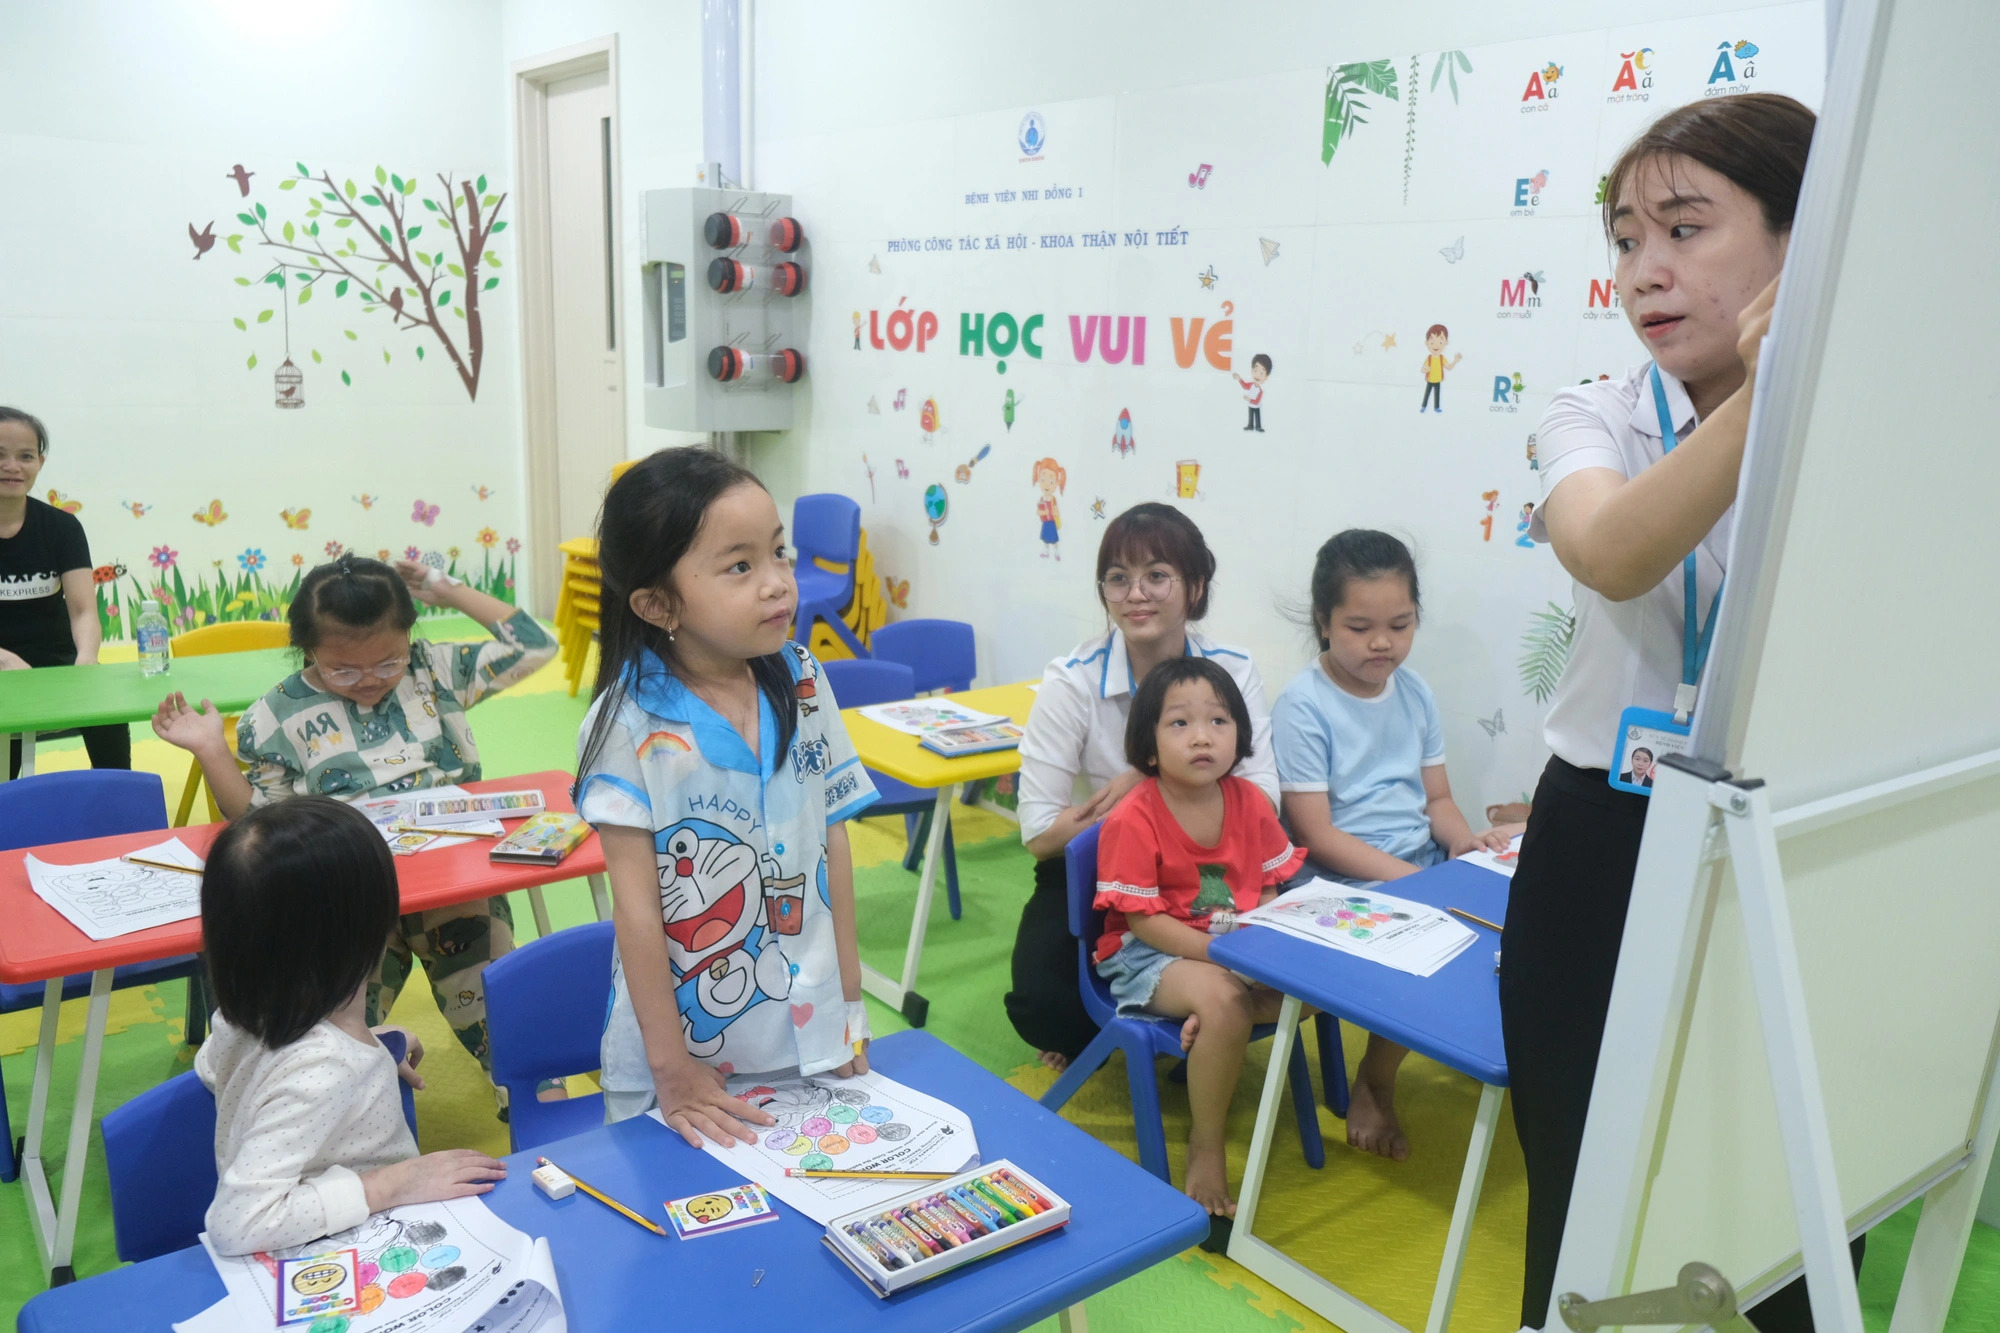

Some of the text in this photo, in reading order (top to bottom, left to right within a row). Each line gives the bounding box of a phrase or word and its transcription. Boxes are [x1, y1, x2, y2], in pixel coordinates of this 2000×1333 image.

[1520, 105, 1536, 114] con
[965, 184, 1083, 206] BỆNH VIỆN NHI ĐỒNG 1
[887, 238, 921, 252] PHÒNG
[924, 237, 953, 251] CÔNG
[959, 235, 980, 250] TÁC
[985, 235, 1000, 250] XÃ
[1006, 233, 1028, 251] HỘI
[1040, 235, 1074, 249] KHOA
[1082, 232, 1117, 250] THẬN
[1124, 229, 1149, 249] NỘI
[1156, 225, 1189, 246] TIẾT
[869, 296, 1234, 375] LỚP HỌC VUI VẺ
[688, 794, 762, 834] HAPPY
[880, 1147, 910, 1164] COLOR
[407, 1296, 451, 1323] COLOR
